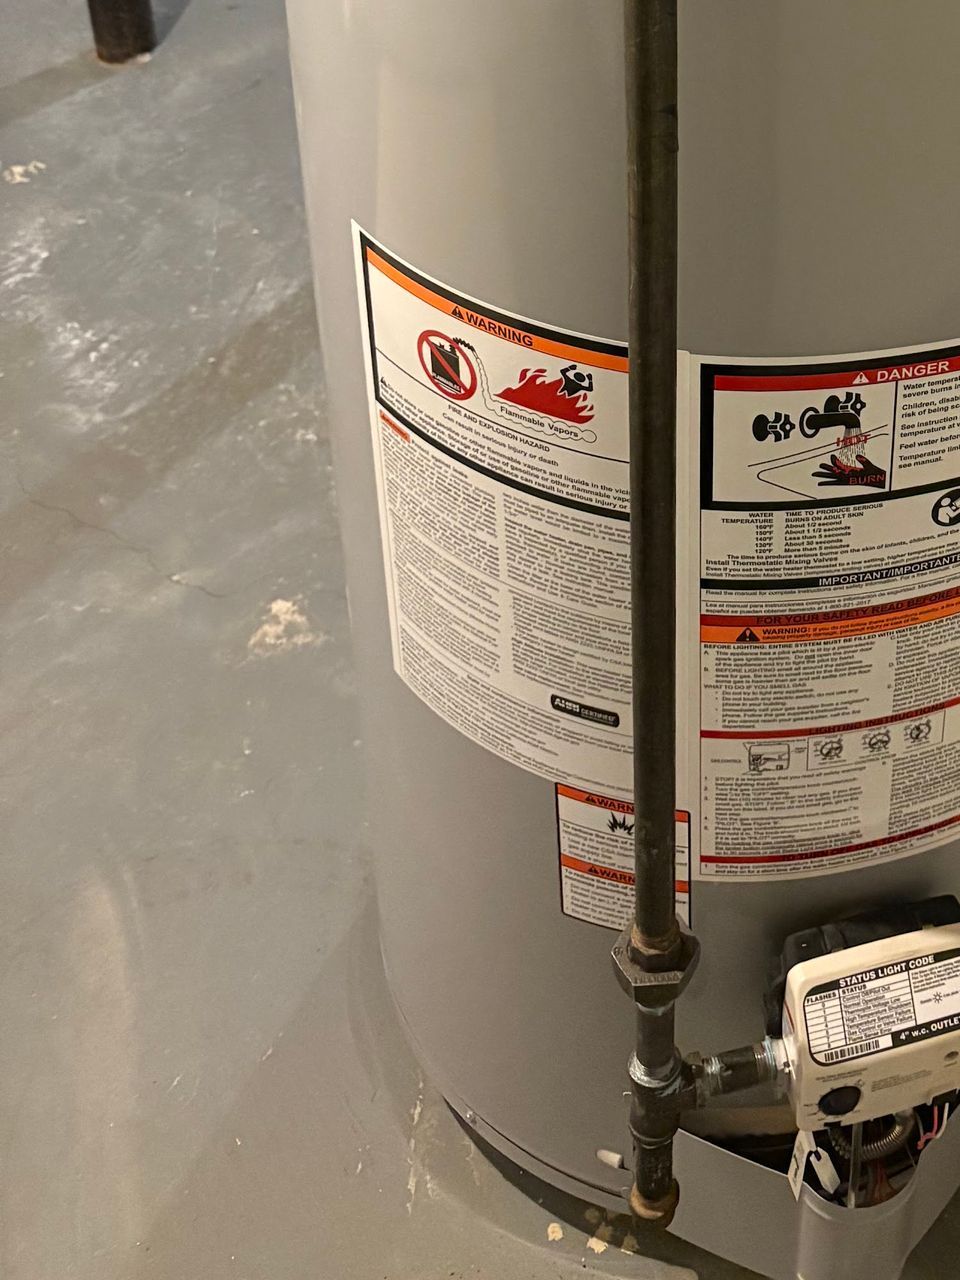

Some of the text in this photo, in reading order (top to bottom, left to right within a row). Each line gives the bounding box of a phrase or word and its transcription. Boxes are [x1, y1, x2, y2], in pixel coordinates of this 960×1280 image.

[466, 311, 533, 346] WARNING
[876, 361, 949, 382] DANGER
[902, 390, 928, 398] severe
[930, 385, 952, 394] burns
[903, 382, 926, 390] Water
[902, 401, 937, 411] Children,
[928, 405, 949, 414] being
[500, 406, 578, 438] Flammable Vapors
[917, 416, 958, 427] instruction
[448, 405, 550, 452] FIRE AND EXPLOSION HAZARD
[900, 425, 946, 438] temperature
[442, 412, 454, 423] Can
[456, 421, 473, 432] result
[482, 434, 506, 447] serious
[508, 444, 527, 457] injury
[538, 456, 559, 466] death
[900, 442, 916, 450] Feel
[899, 449, 946, 461] Temperature
[523, 463, 547, 475] vapors
[549, 471, 562, 479] and
[564, 474, 589, 487] liquids
[850, 474, 885, 484] BURN
[816, 507, 851, 515] PRODUCE
[853, 503, 883, 512] SERIOUS
[756, 615, 782, 625] FOR
[785, 613, 819, 623] YOUR
[823, 608, 868, 621] SAFETY
[871, 602, 904, 615] READ
[907, 592, 951, 609] BEFORE
[762, 627, 810, 635] WARNING:
[839, 955, 935, 987] STATUS LIGHT CODE
[806, 984, 867, 1004] FLASHES STATUS
[911, 1027, 929, 1037] w.c.
